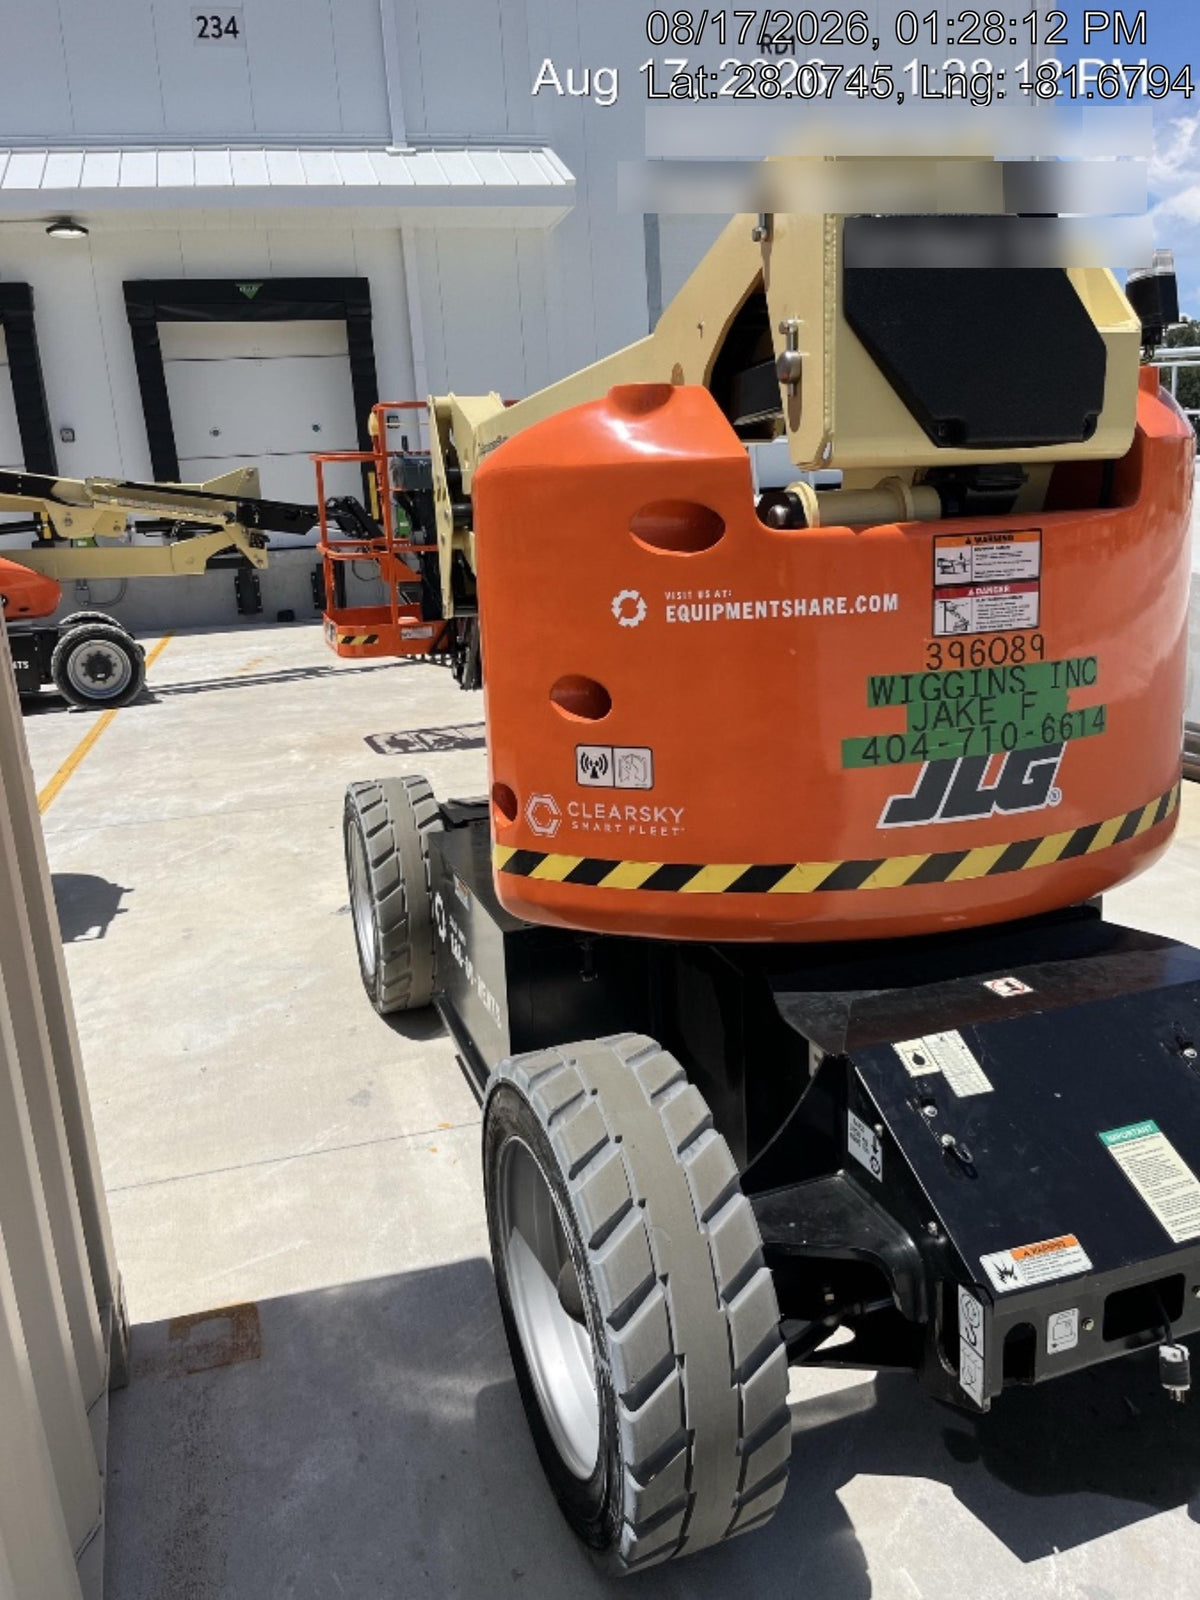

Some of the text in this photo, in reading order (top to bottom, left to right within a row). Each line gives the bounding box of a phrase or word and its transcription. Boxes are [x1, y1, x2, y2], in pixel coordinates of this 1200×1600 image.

[196, 15, 240, 39] 234
[664, 589, 732, 601] VISIT US AT:
[665, 593, 898, 623] EQUIPMENTSHARE.COM
[926, 634, 1045, 670] 396089
[870, 657, 1097, 706] WIGGINS INC
[912, 691, 1038, 732] JAKE F
[862, 704, 1105, 765] 404-710-6614
[567, 800, 685, 824] CLEARSKY
[571, 821, 680, 837] SMART FLEET
